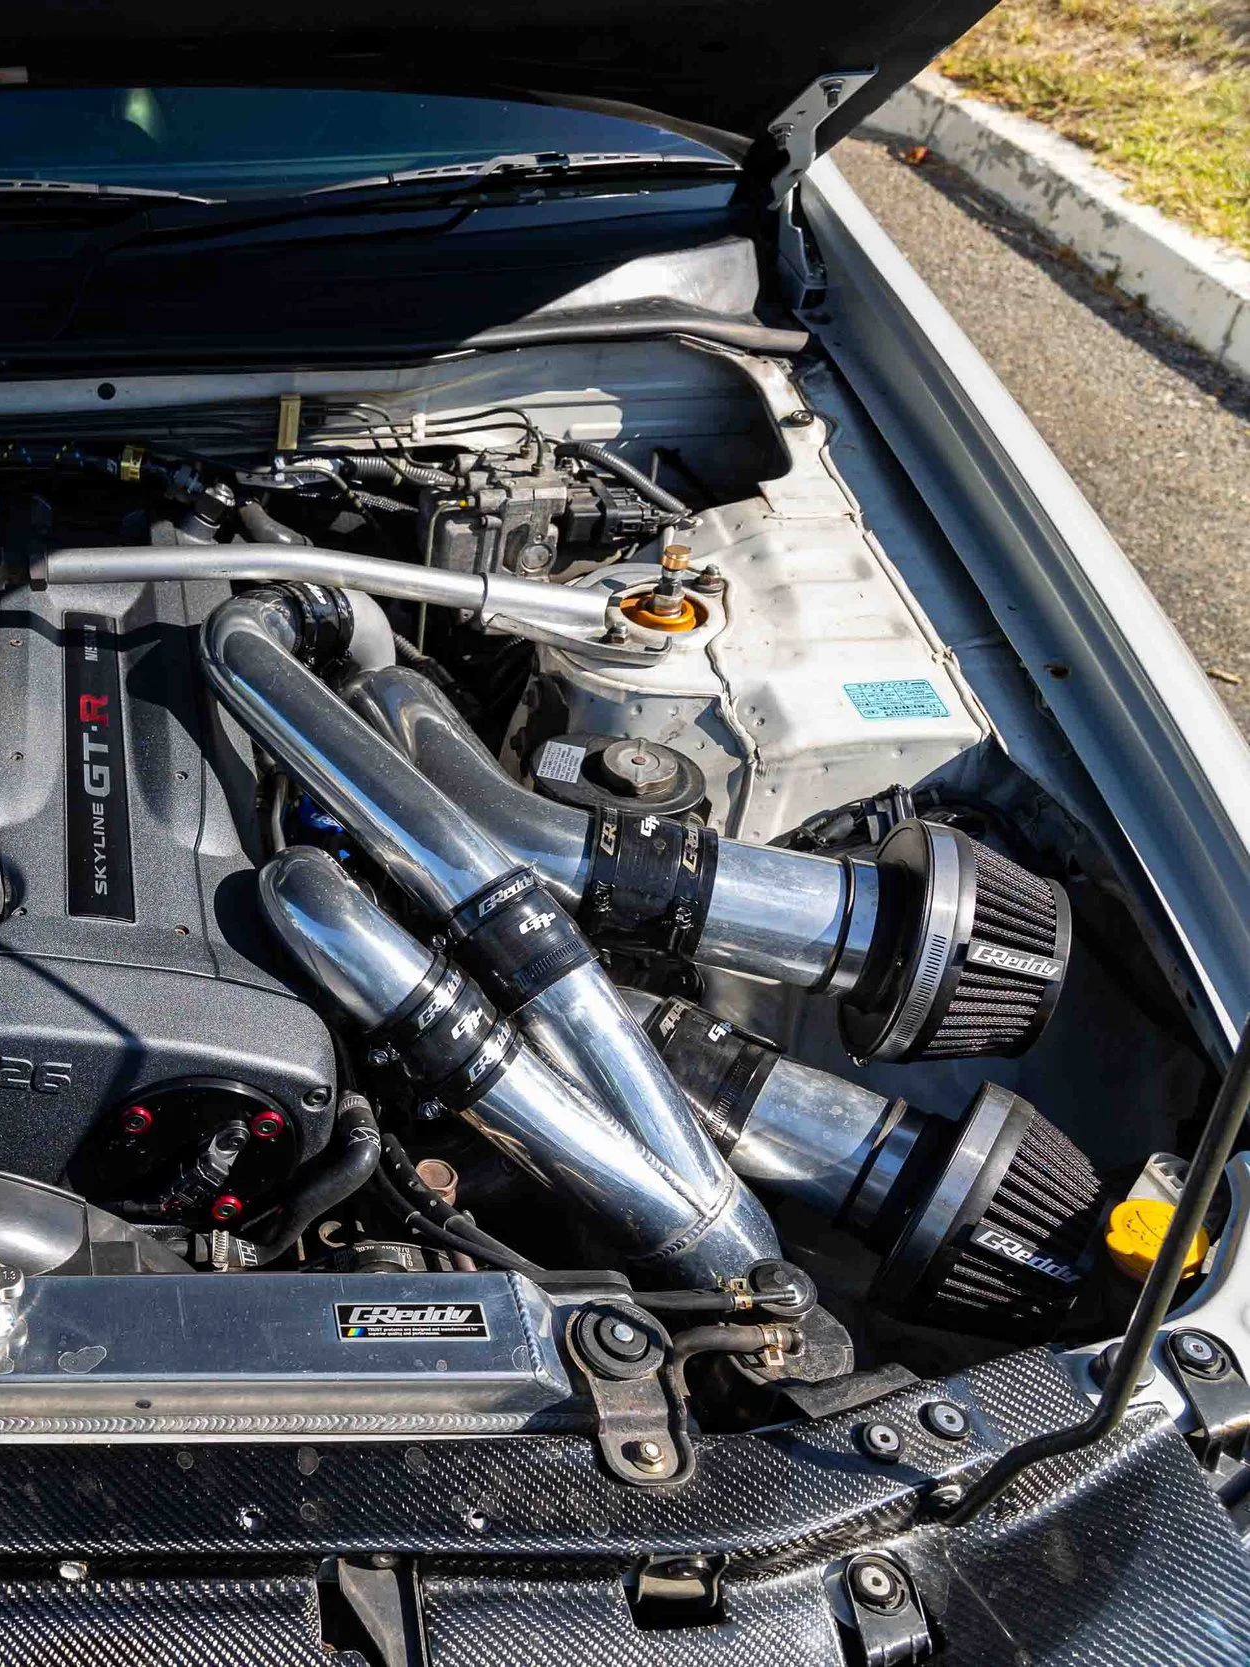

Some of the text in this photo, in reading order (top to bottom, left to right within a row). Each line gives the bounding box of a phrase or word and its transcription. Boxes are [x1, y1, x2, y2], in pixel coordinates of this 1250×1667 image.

[94, 803, 108, 896] SKYLINE
[479, 875, 535, 917] GReddy
[972, 945, 1060, 977] GReddy
[418, 969, 462, 1031] GRddy
[468, 1022, 512, 1083] GRddy
[2, 1270, 17, 1281] 1.3
[976, 1230, 1083, 1283] GReddy
[348, 1306, 473, 1324] GReddy
